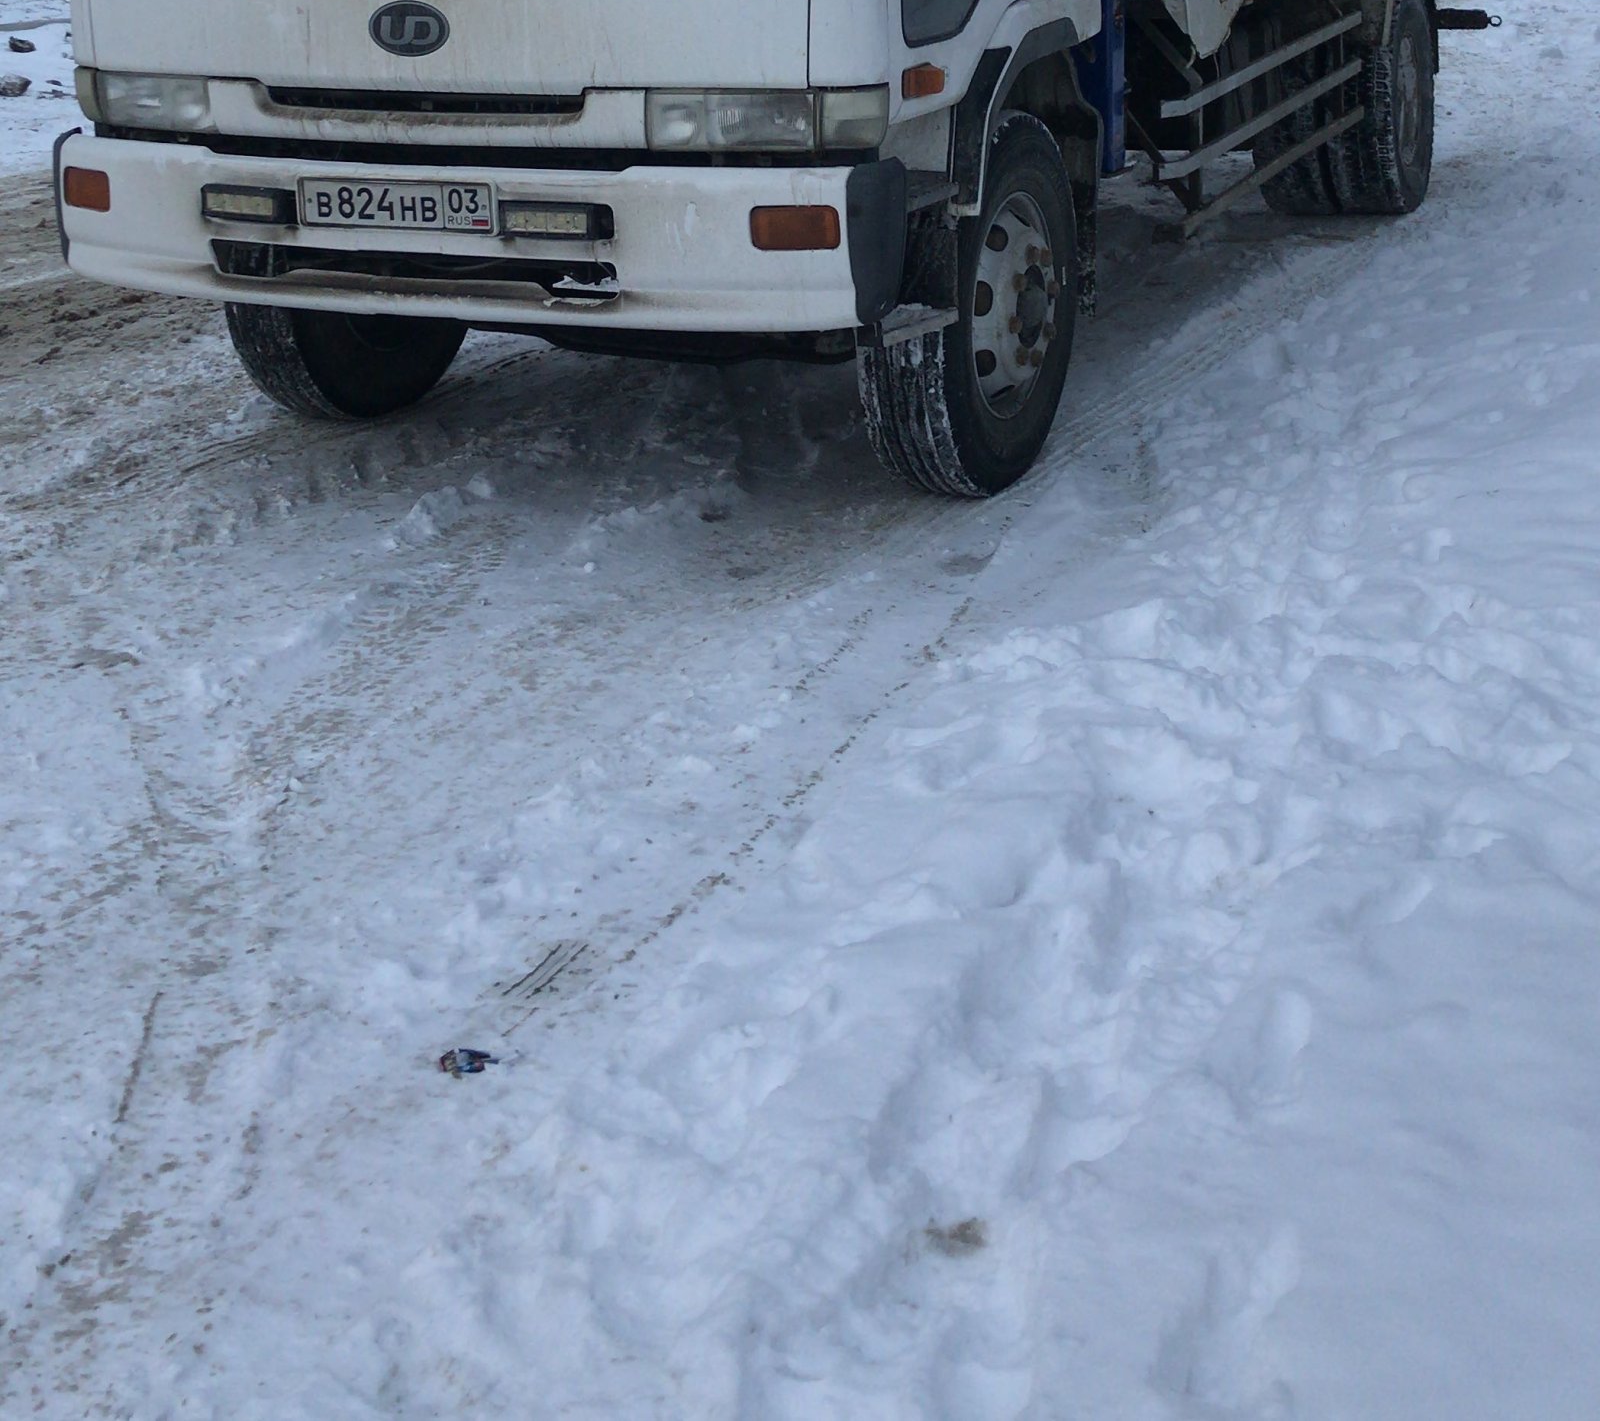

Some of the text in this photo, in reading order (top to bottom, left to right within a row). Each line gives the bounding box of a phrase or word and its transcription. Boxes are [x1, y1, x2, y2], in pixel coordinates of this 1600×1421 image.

[380, 15, 440, 46] UD
[448, 188, 480, 215] 03
[447, 215, 472, 227] RUS
